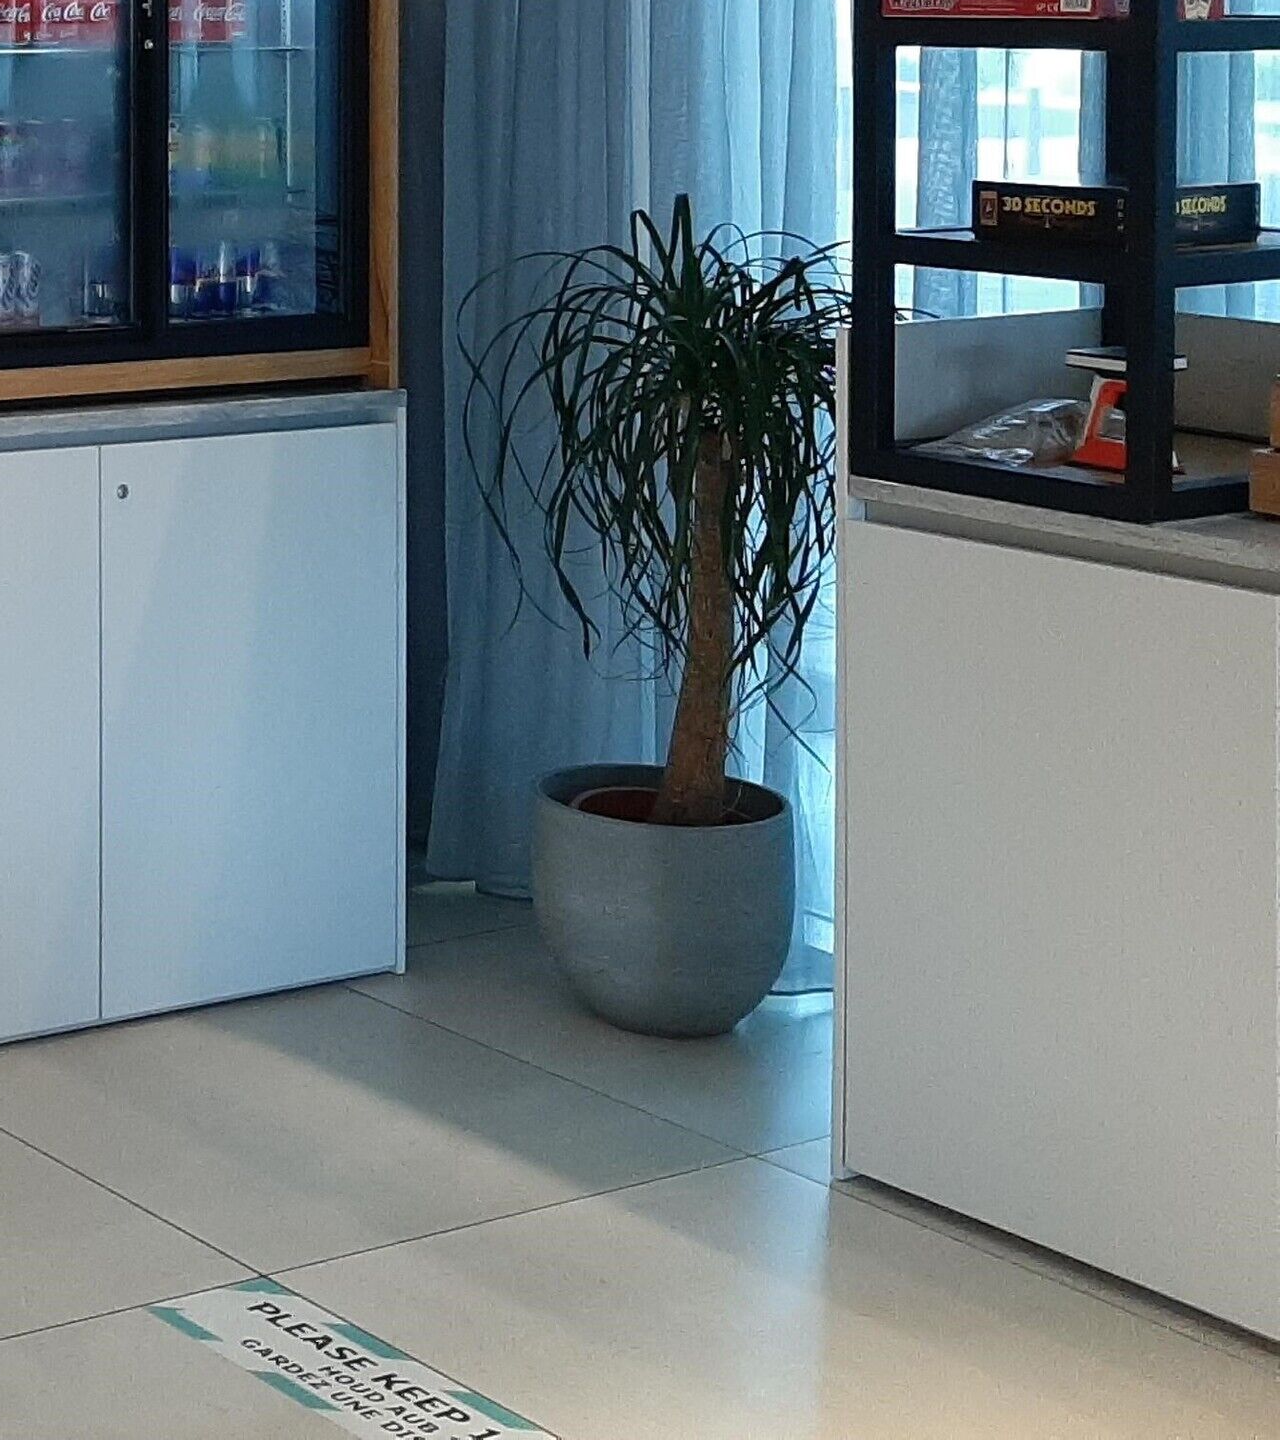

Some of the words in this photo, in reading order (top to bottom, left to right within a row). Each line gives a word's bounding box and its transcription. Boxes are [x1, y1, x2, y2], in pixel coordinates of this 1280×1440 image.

[1023, 197, 1098, 216] SECONDS
[241, 1339, 333, 1390] GARDEZ
[330, 1392, 384, 1420] UNE
[247, 1301, 379, 1372] PLEASE
[371, 1373, 471, 1423] KEEP
[318, 1366, 386, 1403] HOUD
